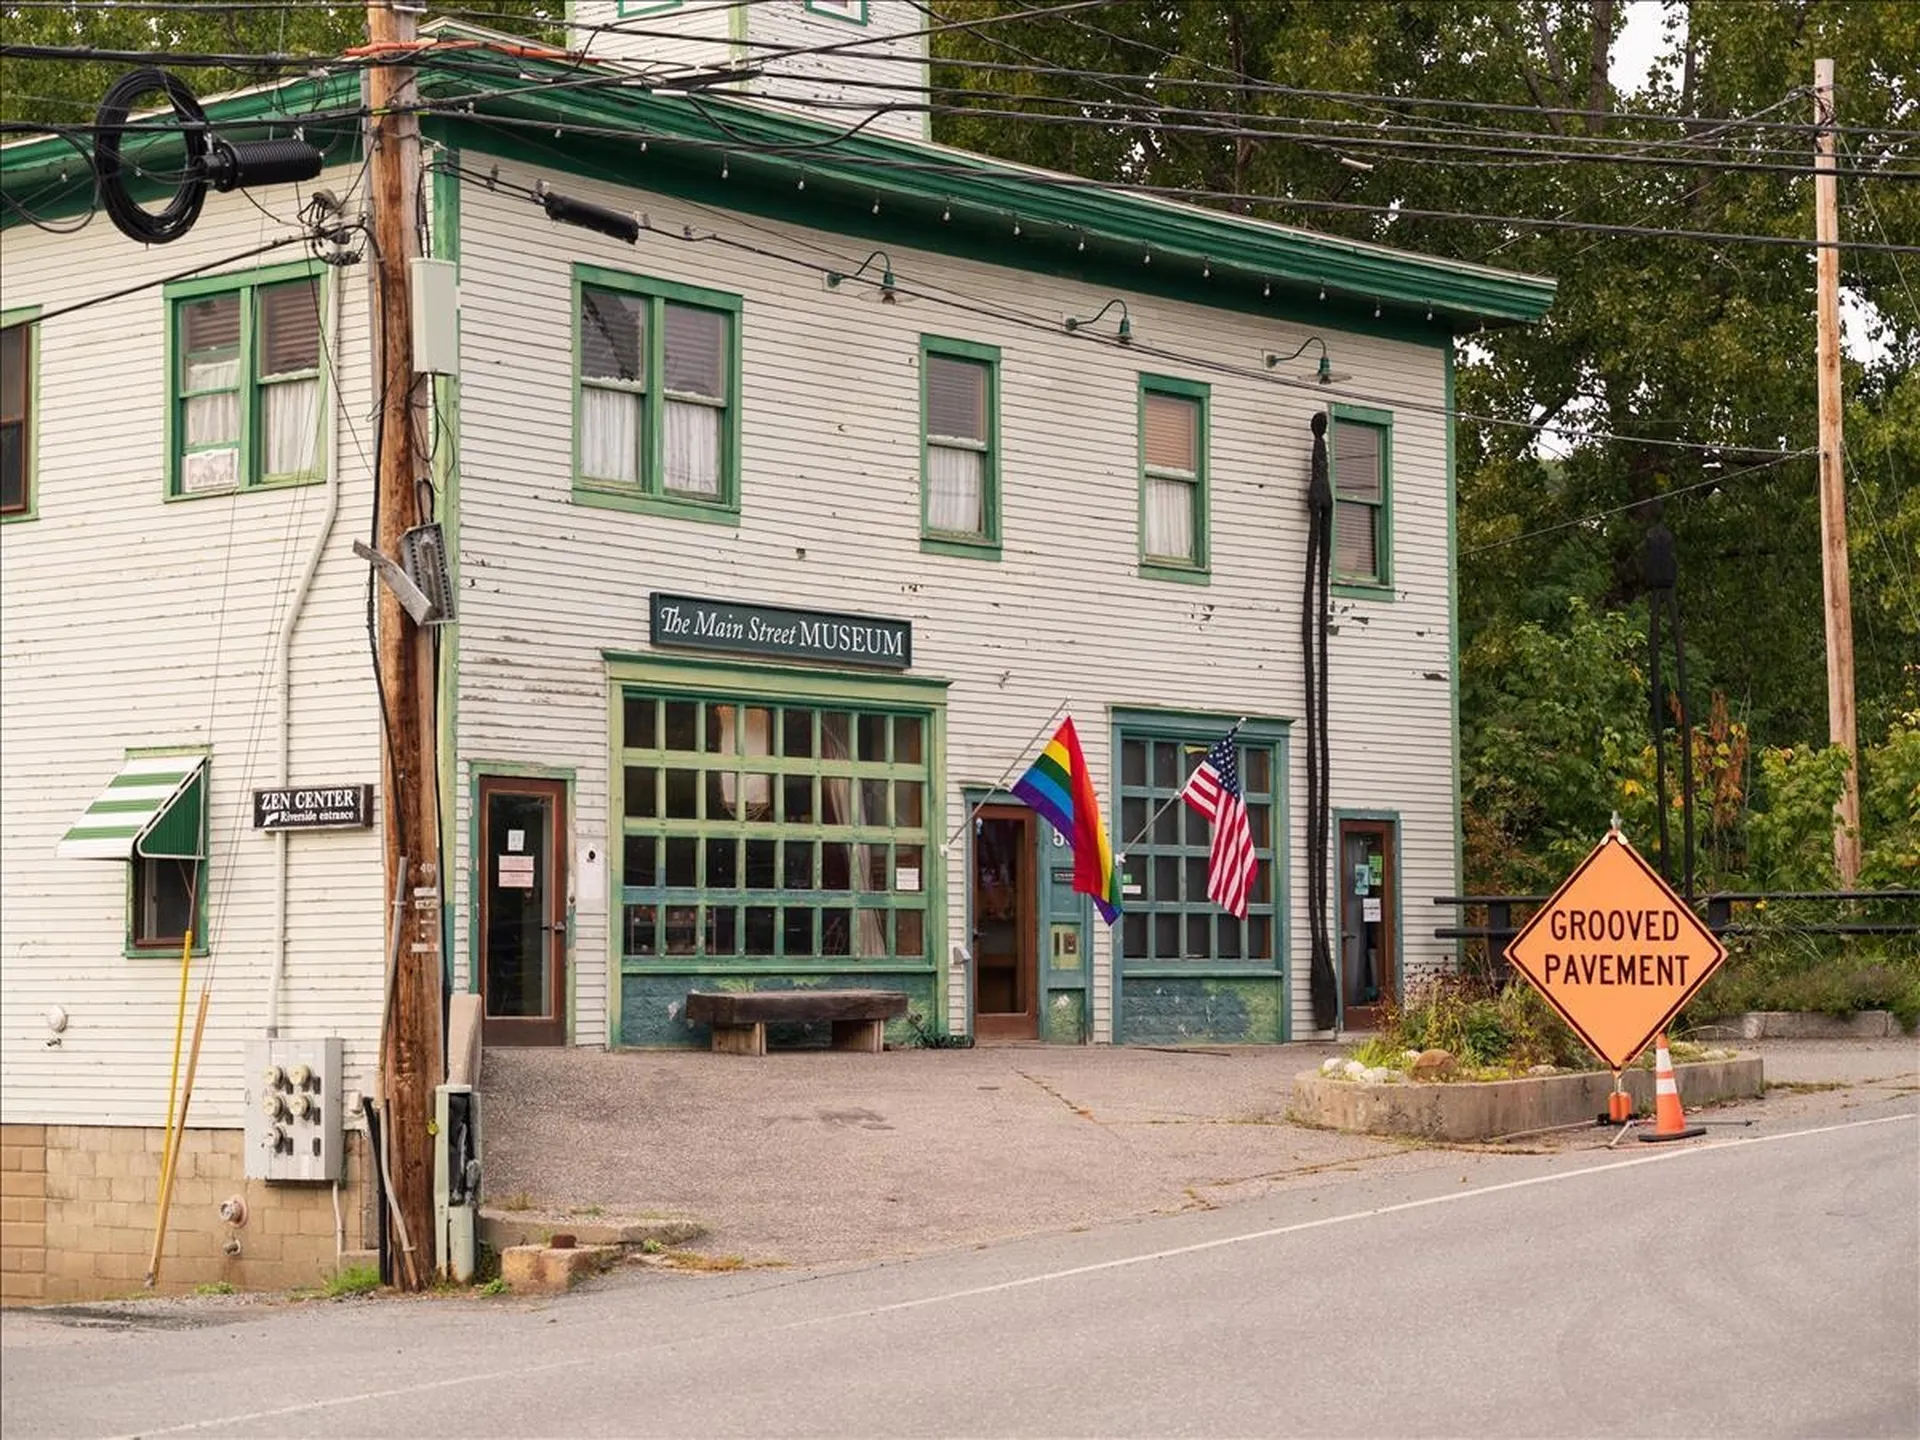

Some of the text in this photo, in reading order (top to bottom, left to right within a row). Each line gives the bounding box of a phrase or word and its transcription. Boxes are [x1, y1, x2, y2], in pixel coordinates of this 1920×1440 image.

[660, 606, 904, 656] The Main Street MUSEUM
[262, 789, 354, 810] ZEN CENTER
[280, 810, 354, 822] Riverside entrance
[1551, 911, 1679, 941] GROOVED
[1545, 954, 1690, 986] PAVEMENT
